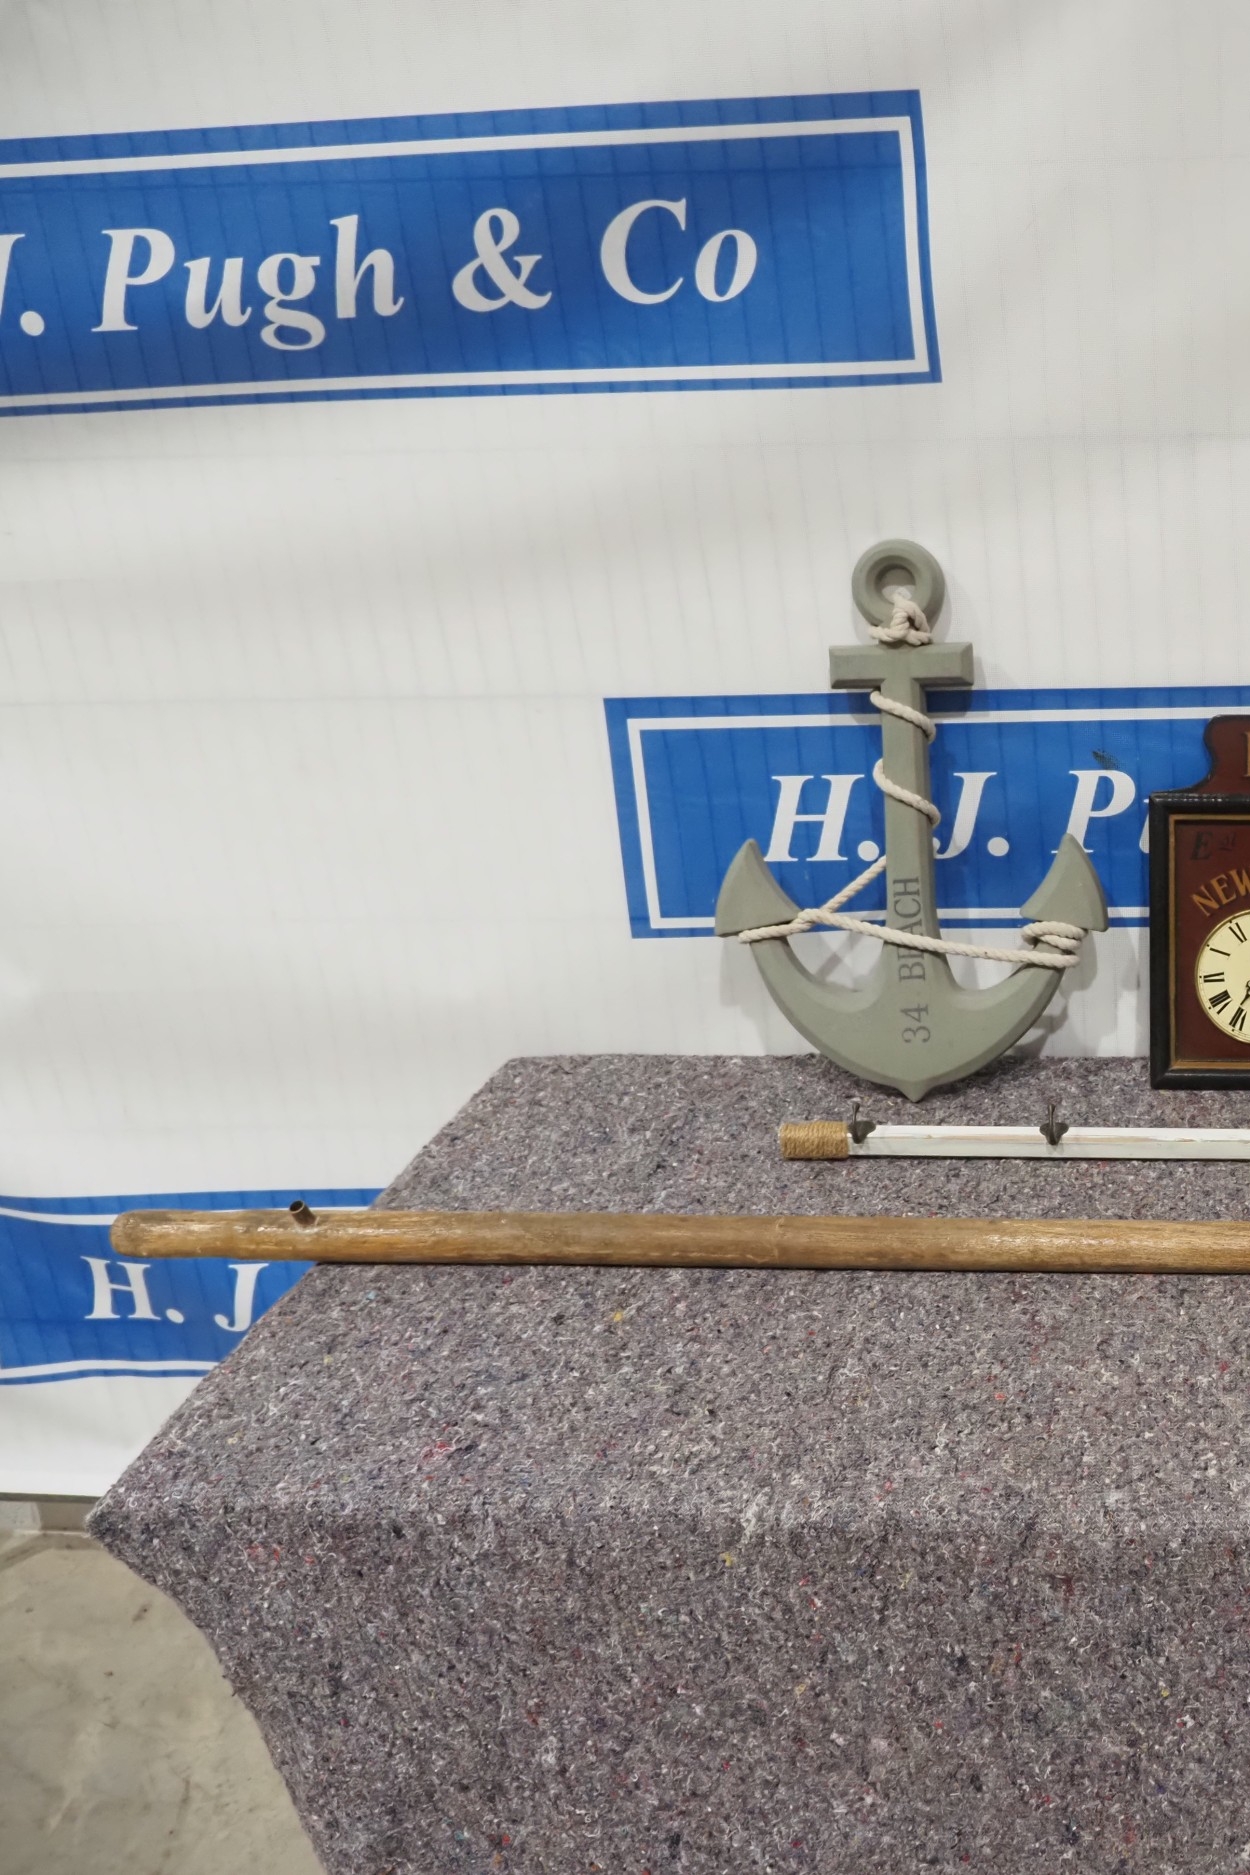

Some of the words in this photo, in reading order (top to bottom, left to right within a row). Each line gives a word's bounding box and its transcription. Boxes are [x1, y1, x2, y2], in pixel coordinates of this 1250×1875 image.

[90, 213, 405, 353] Pugh
[451, 207, 553, 313] &
[599, 197, 759, 307] Co
[764, 773, 881, 863] H.
[932, 771, 1011, 861] J.
[900, 1003, 932, 1044] 34
[80, 1255, 185, 1325] H.
